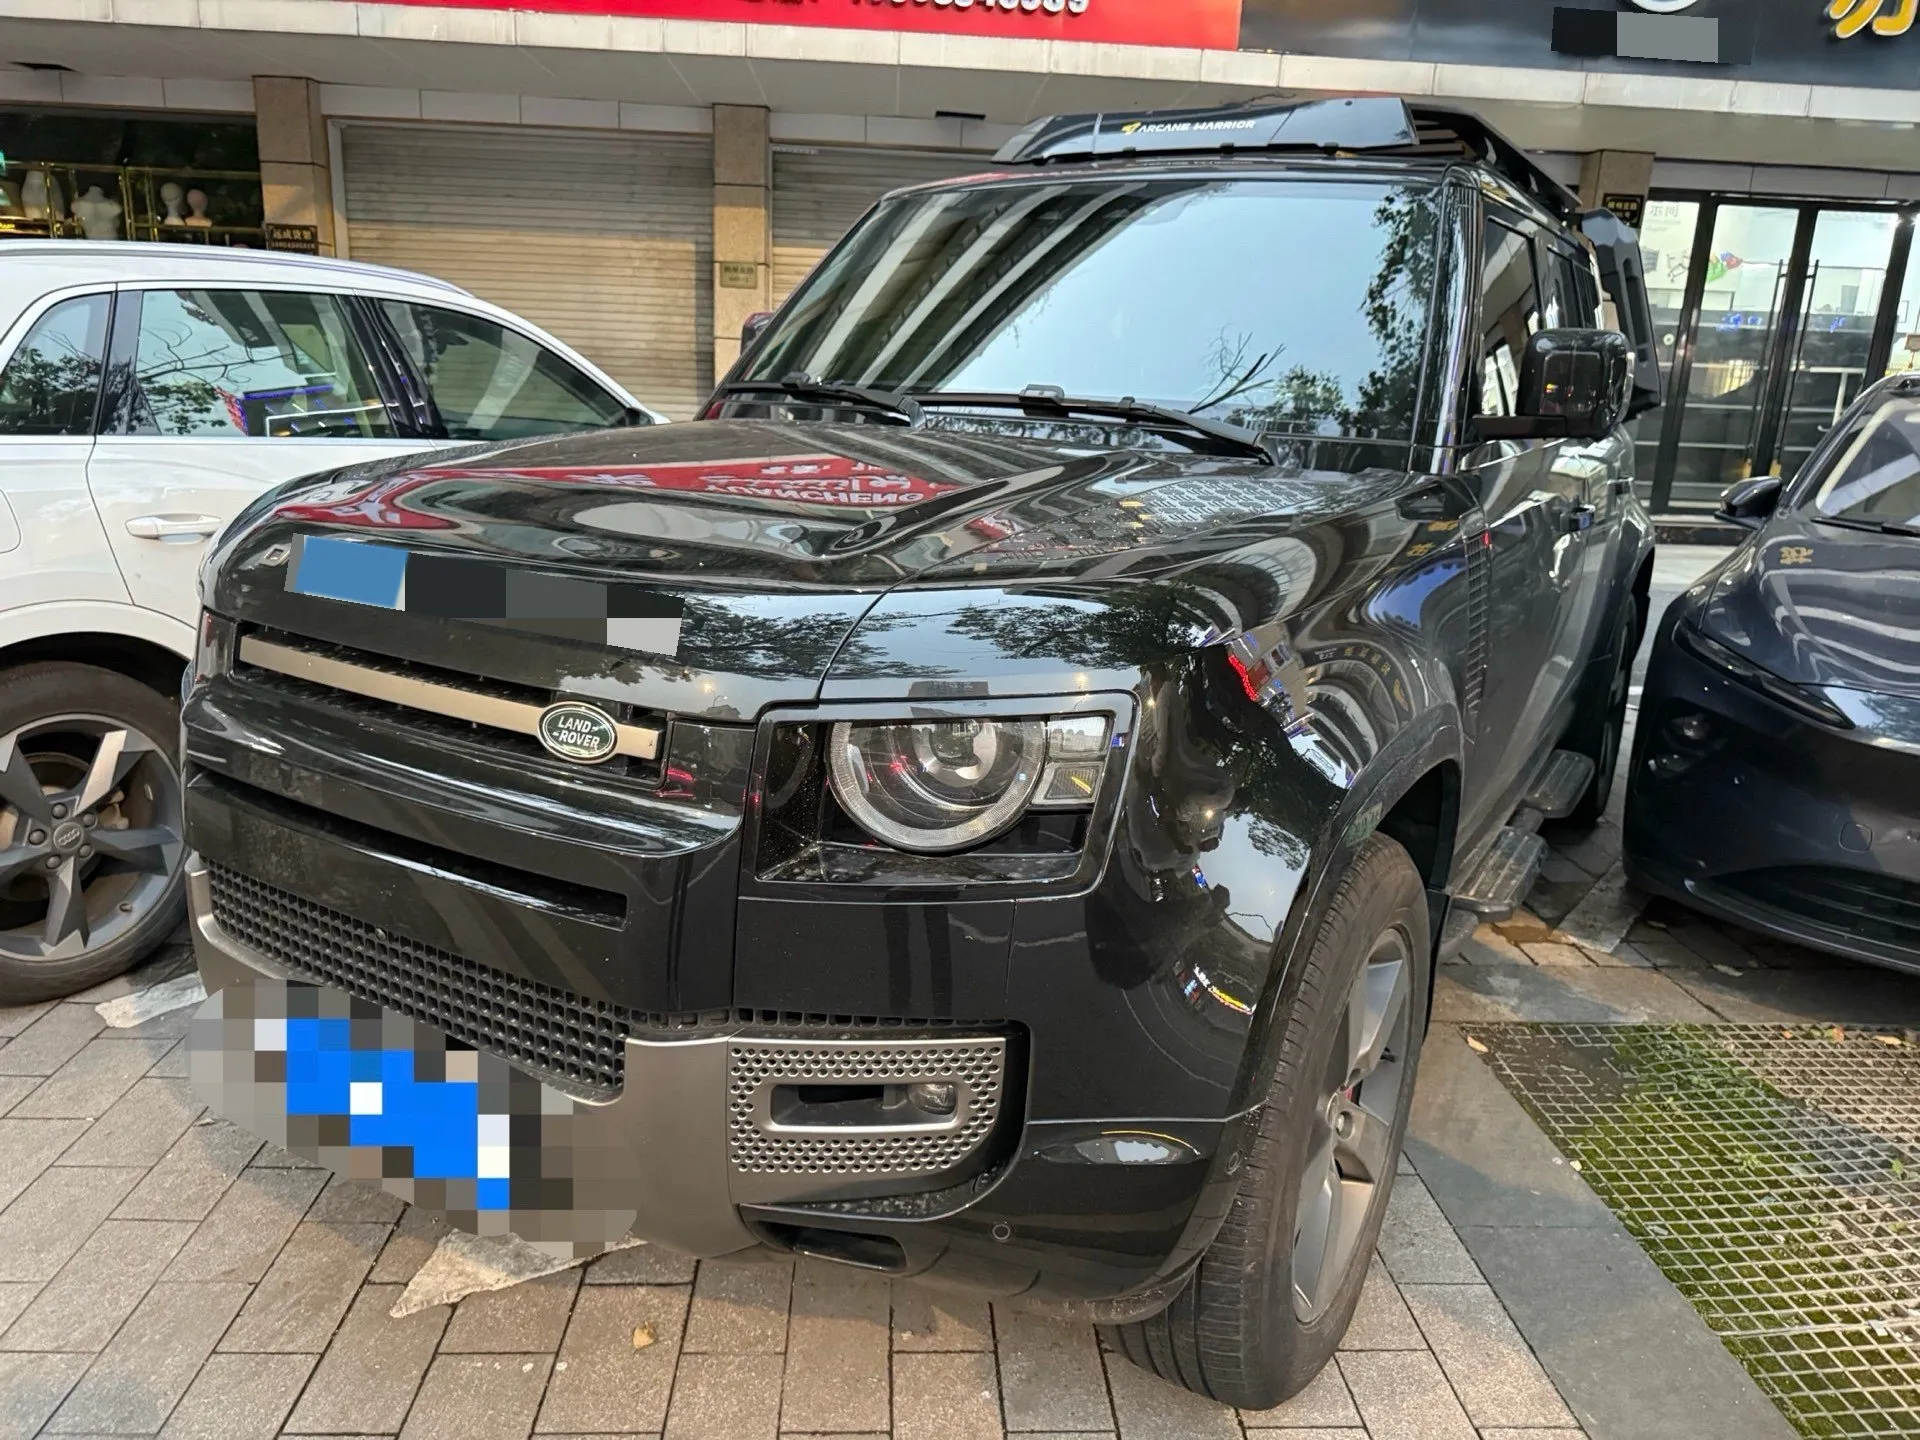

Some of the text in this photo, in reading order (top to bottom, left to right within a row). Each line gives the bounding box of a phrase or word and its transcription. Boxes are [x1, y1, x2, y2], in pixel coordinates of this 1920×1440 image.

[1138, 119, 1256, 133] ARCANE WARRIOR
[558, 716, 592, 733] LAND
[559, 730, 600, 751] ROVER
